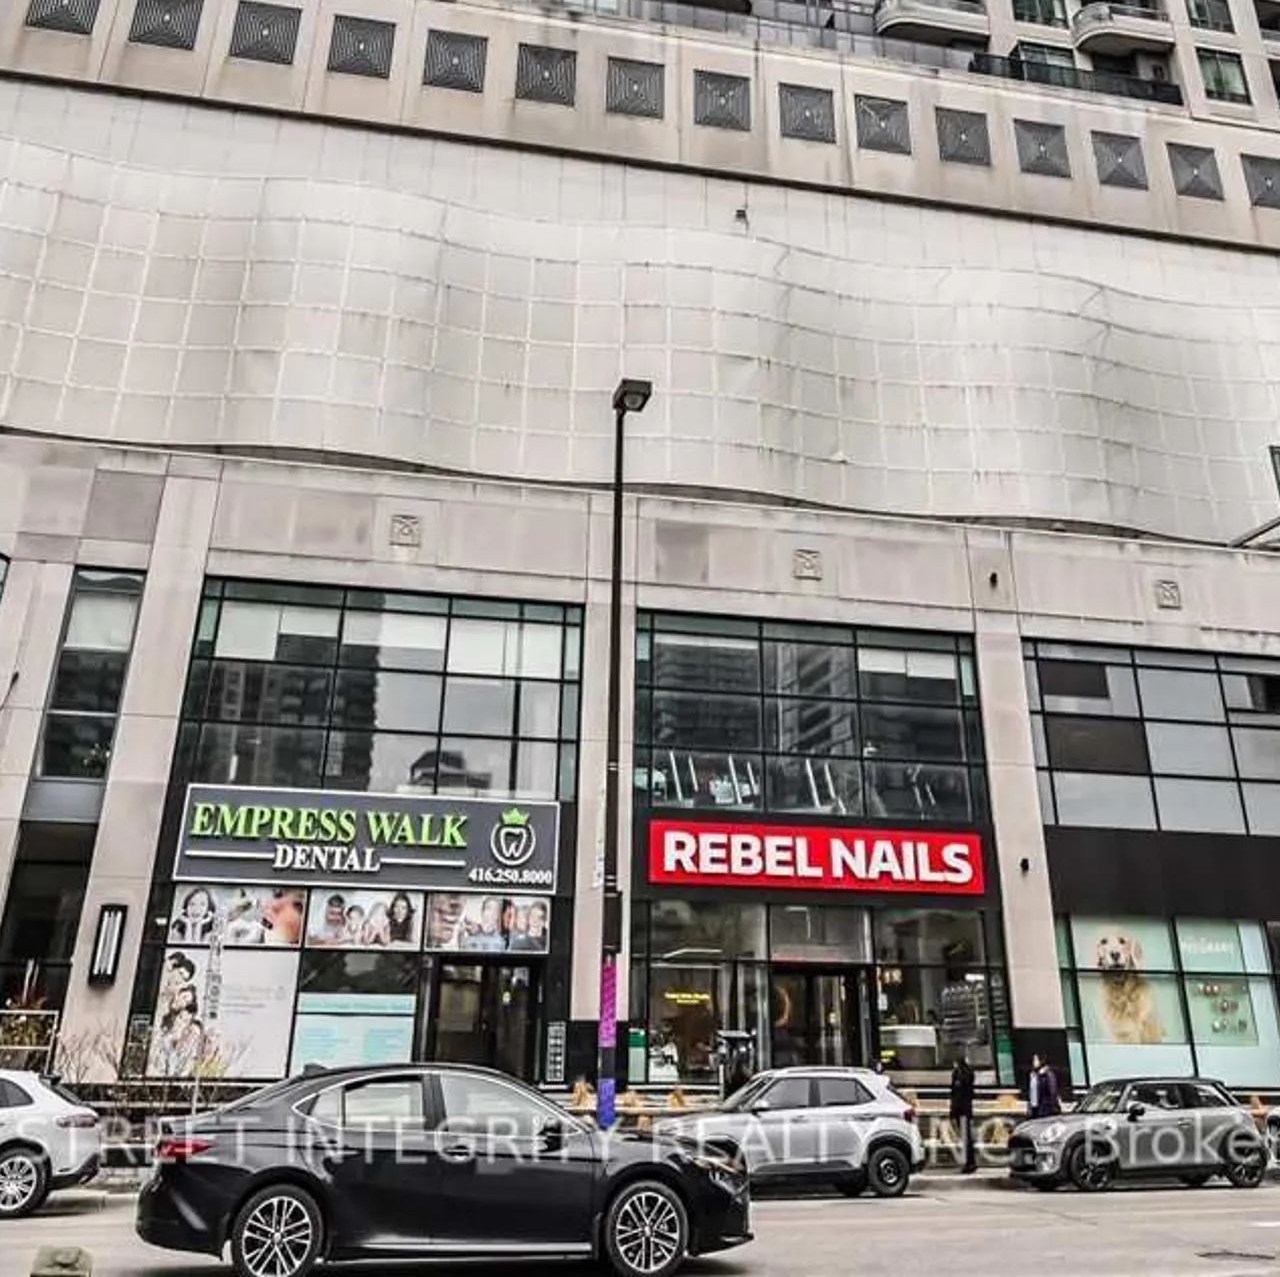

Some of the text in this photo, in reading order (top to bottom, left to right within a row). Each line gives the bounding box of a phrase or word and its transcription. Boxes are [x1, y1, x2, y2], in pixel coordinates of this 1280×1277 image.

[189, 801, 469, 848] EMPRESS WALK
[272, 844, 381, 873] DENTAL
[467, 867, 554, 885] 416.250.8000
[663, 829, 974, 885] REBEL NAILS
